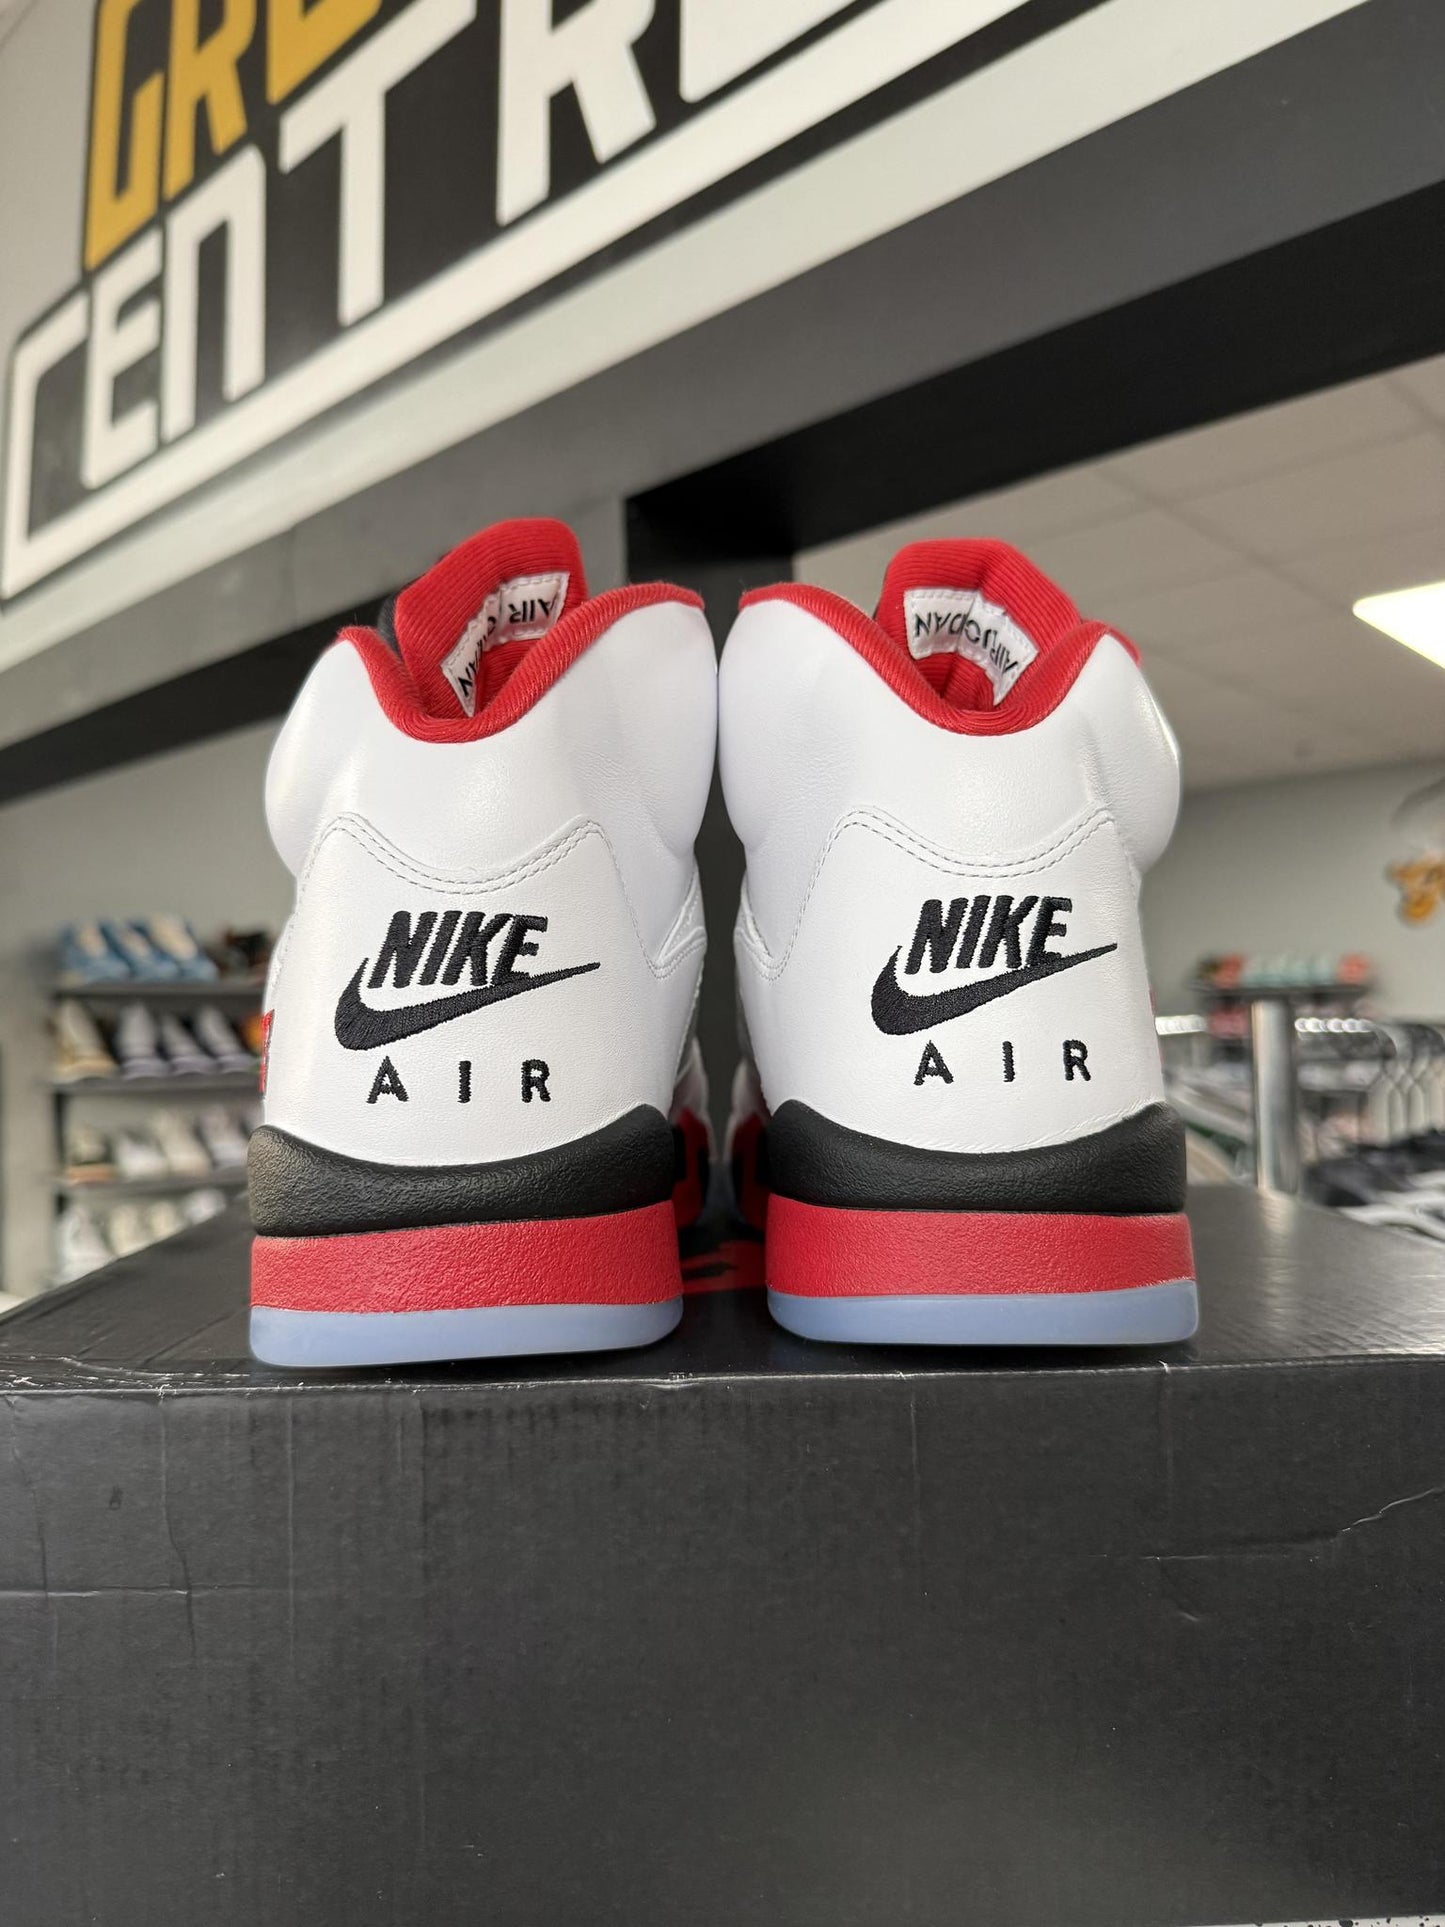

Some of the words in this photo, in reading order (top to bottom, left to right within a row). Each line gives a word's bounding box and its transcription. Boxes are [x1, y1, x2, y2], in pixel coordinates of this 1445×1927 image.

[508, 593, 558, 624] AIR
[366, 910, 548, 989] NIKE
[903, 895, 1073, 975] NIKE
[366, 1055, 551, 1104] AIR
[914, 1039, 1091, 1085] AIR
